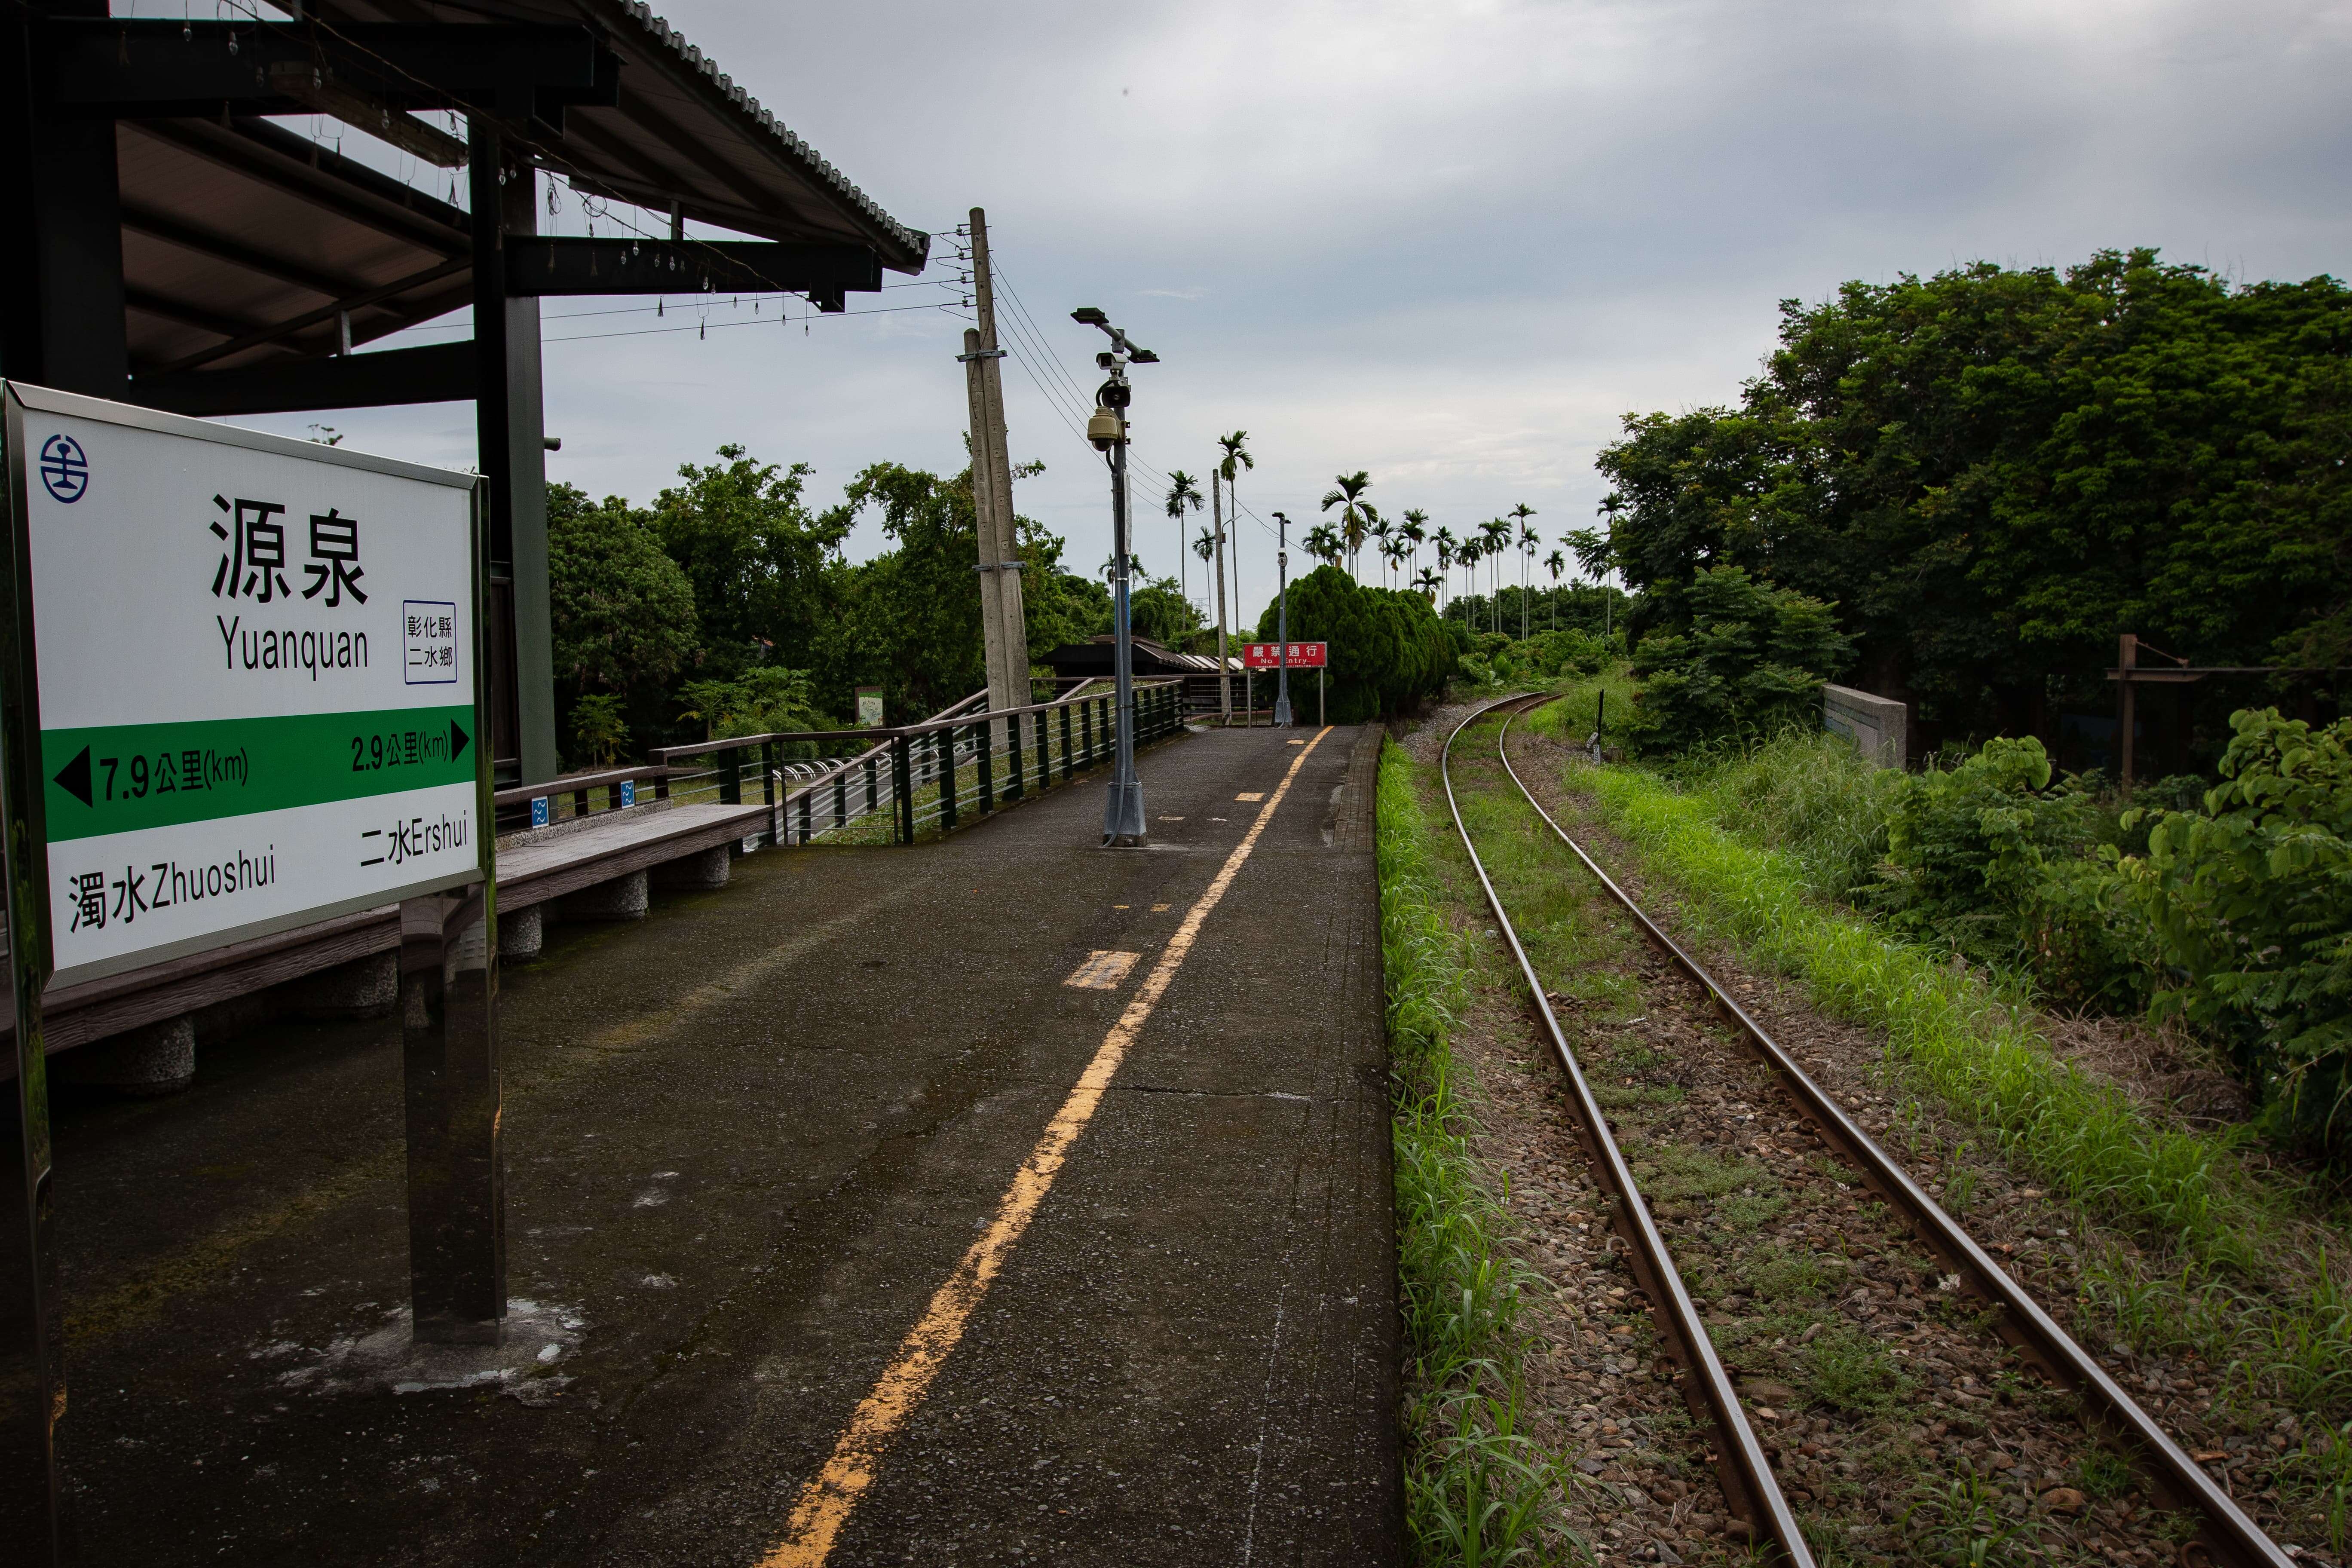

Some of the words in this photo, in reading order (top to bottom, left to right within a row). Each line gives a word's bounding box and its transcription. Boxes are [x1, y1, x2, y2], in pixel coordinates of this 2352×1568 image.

[209, 493, 368, 608] 源泉
[407, 615, 452, 638] 彰化縣
[216, 615, 368, 682] Yuanquan
[409, 646, 453, 668] 二水鄉
[1253, 646, 1317, 657] 嚴禁通行
